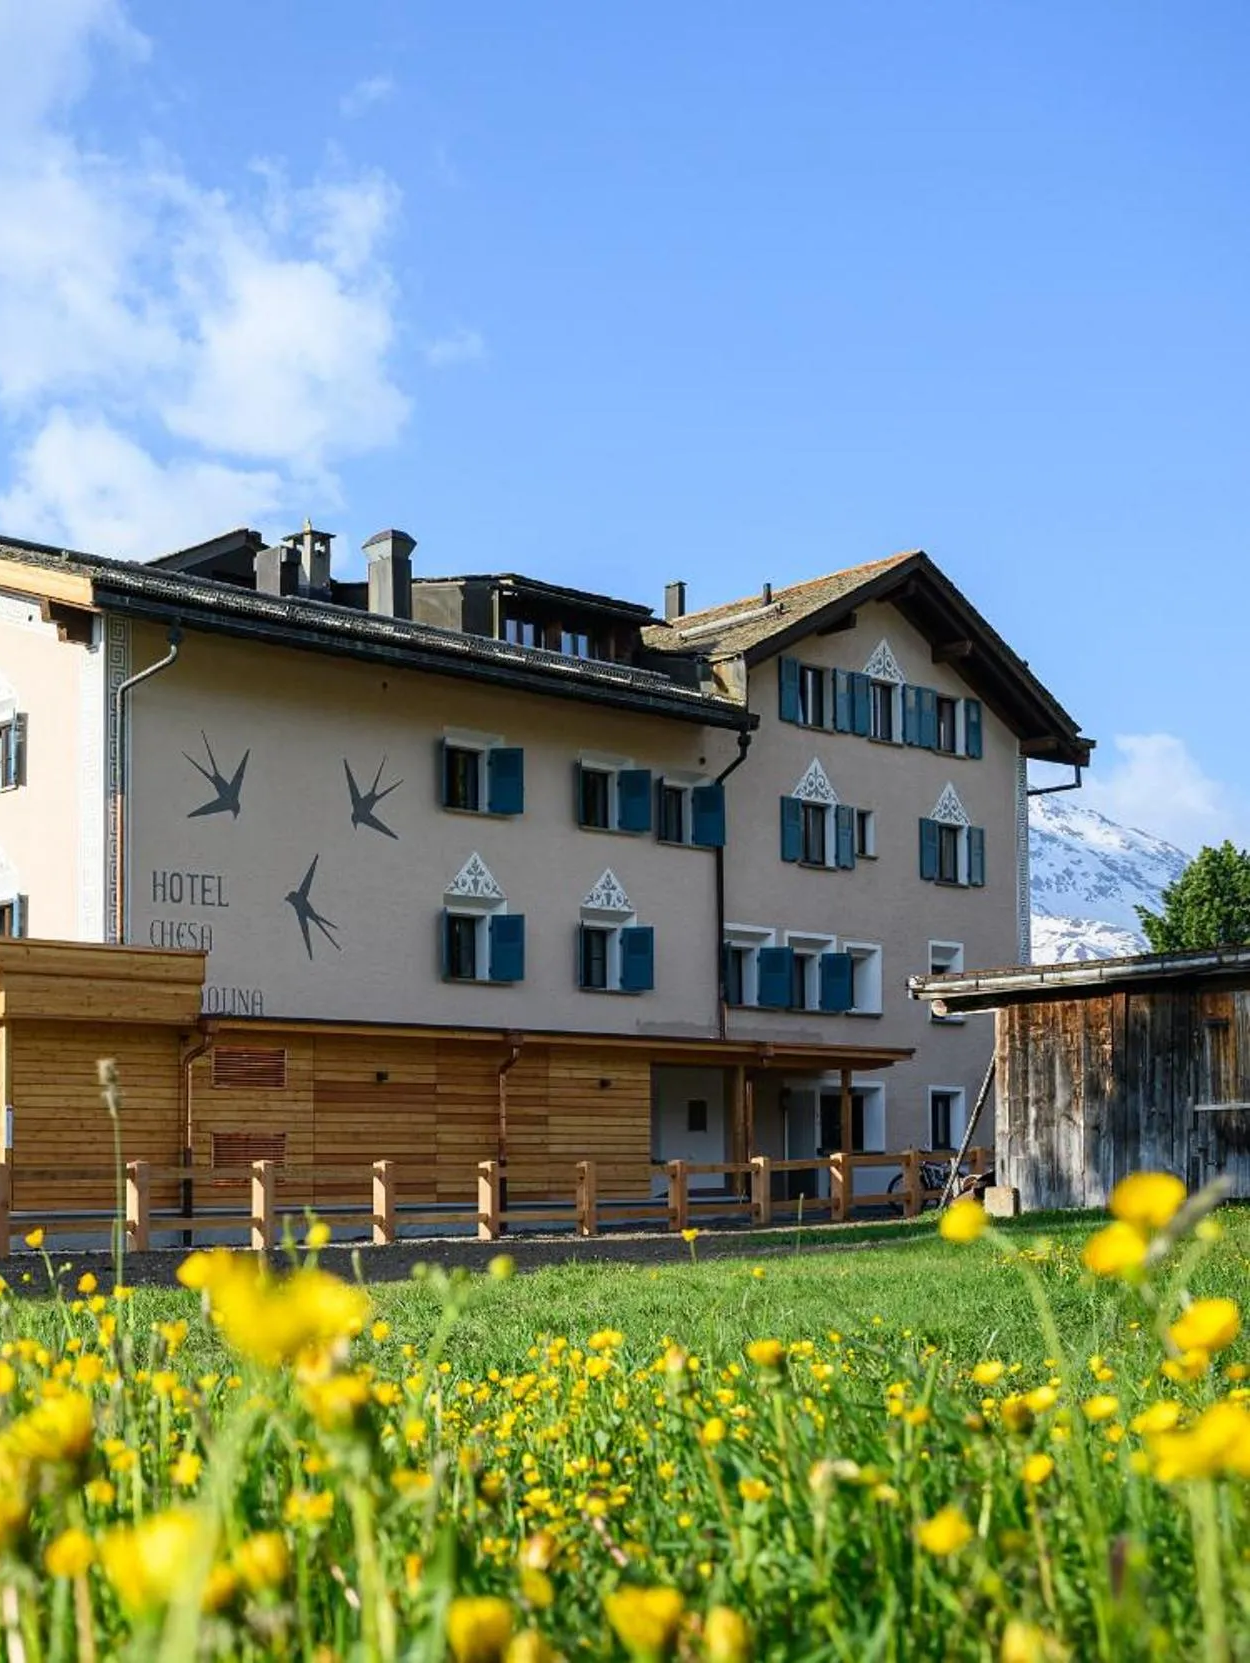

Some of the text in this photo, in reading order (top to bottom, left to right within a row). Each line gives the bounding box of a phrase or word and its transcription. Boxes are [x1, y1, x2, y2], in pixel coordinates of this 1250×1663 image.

[152, 870, 229, 907] HOTEL
[150, 919, 212, 951] CHESA
[200, 986, 264, 1016] OLINA
